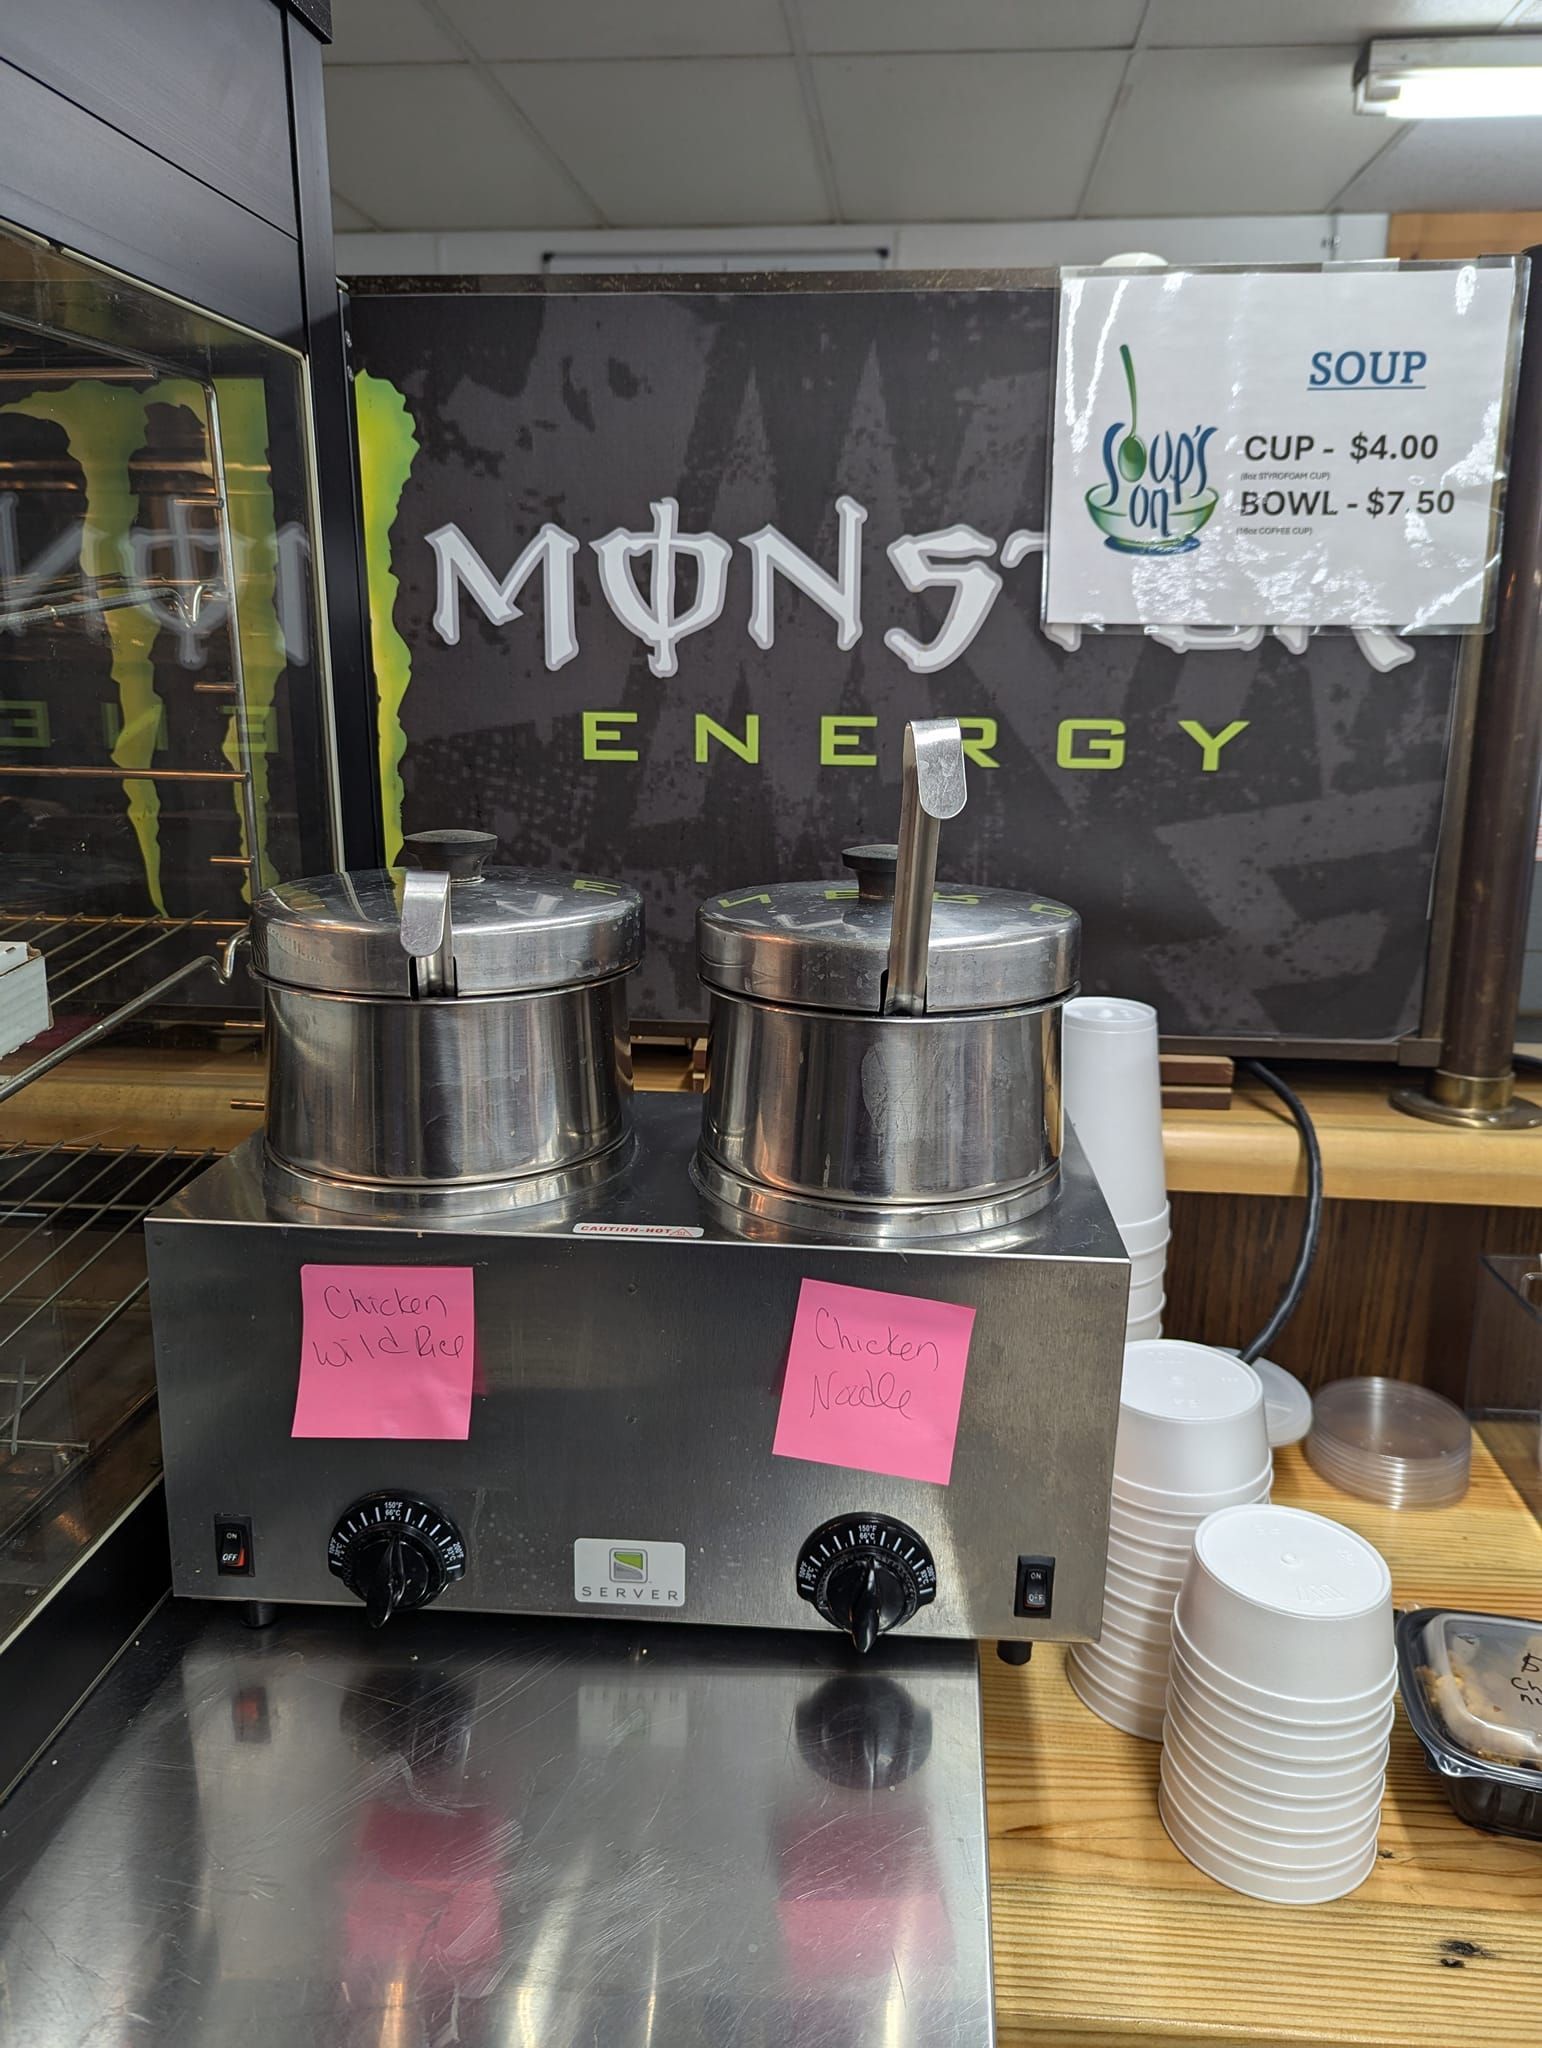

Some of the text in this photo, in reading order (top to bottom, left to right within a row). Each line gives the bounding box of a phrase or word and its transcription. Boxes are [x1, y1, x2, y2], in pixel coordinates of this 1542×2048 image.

[1308, 350, 1428, 386] SOUP
[1244, 435, 1315, 461] CUP
[1350, 431, 1439, 464] $4.00
[1240, 490, 1339, 517] BOWL
[582, 711, 1250, 772] ENERGY
[324, 1285, 447, 1319] Chicken
[815, 1307, 939, 1371] Chicken
[222, 1553, 239, 1561] OFF
[1030, 1572, 1042, 1580] ON
[581, 1586, 679, 1601] SERVER
